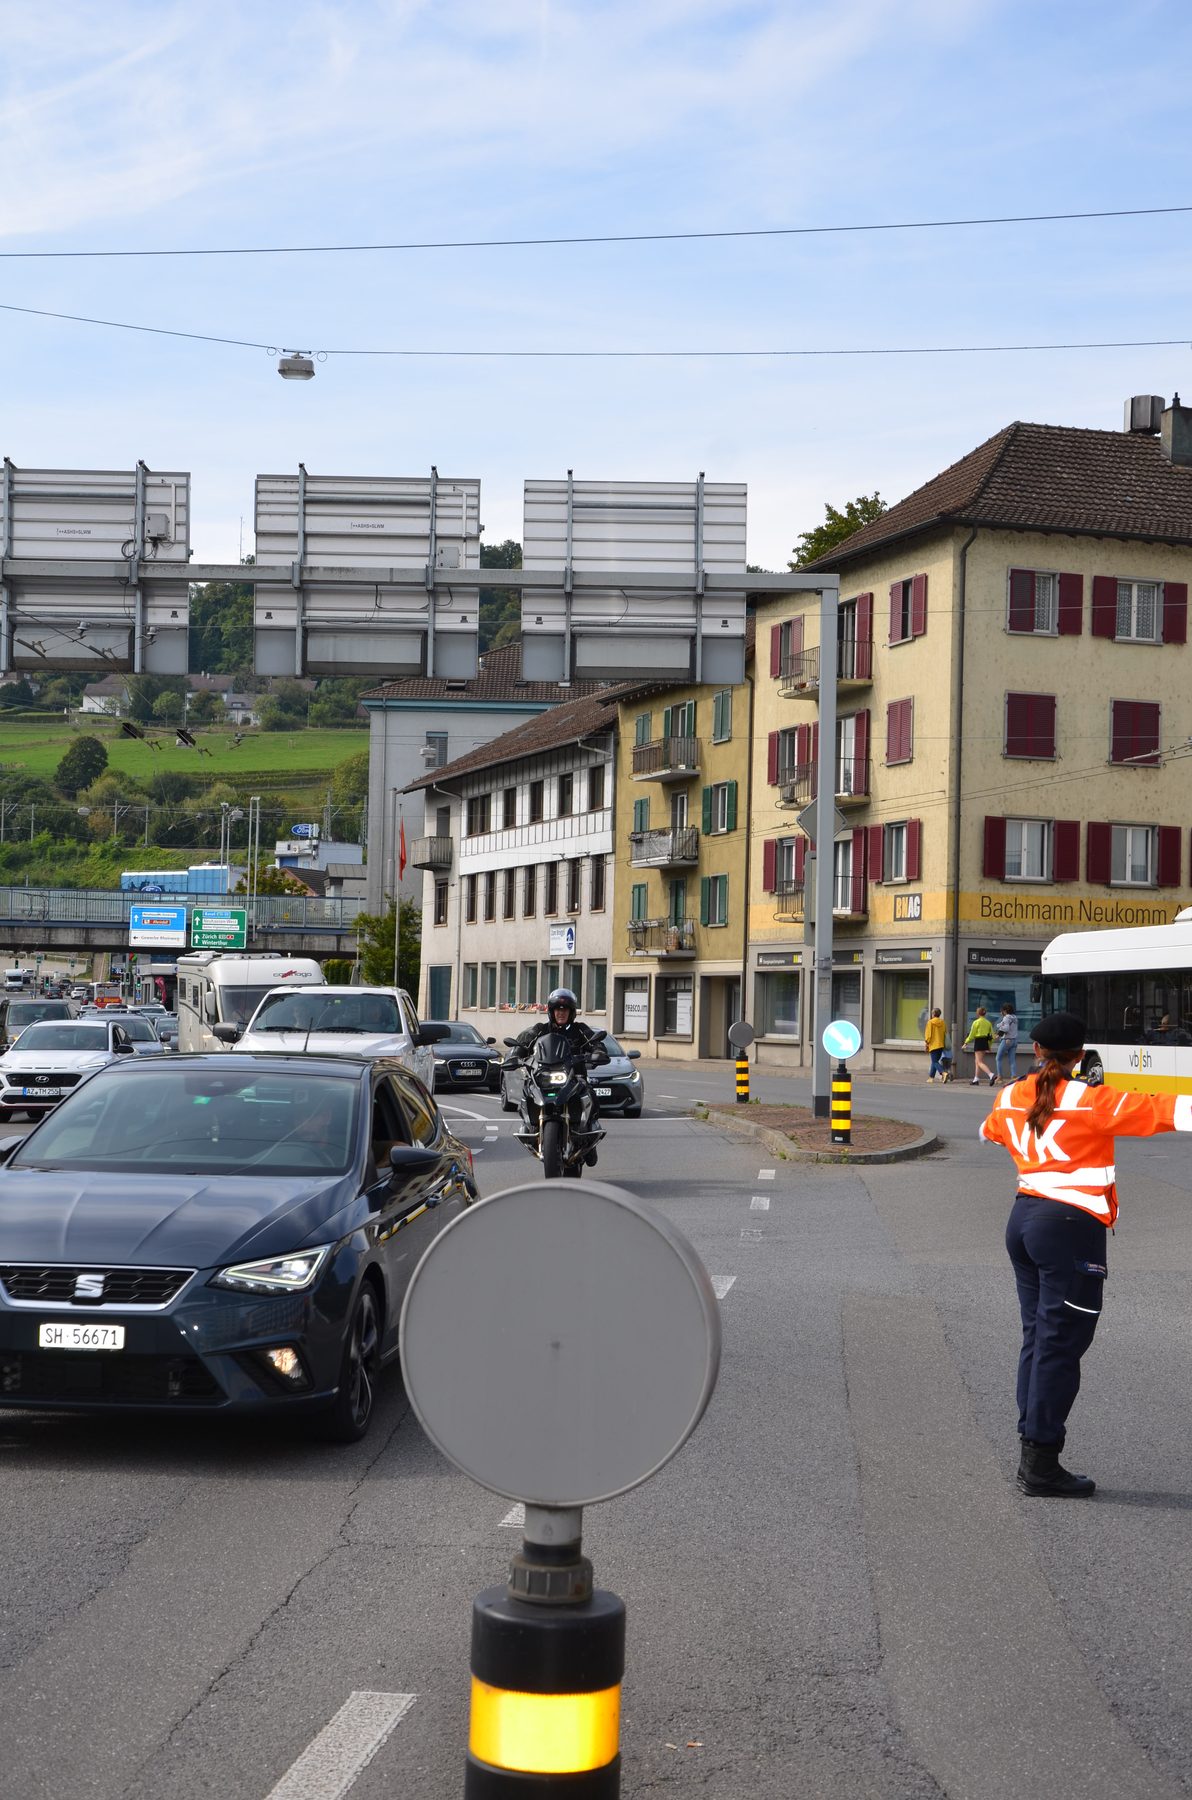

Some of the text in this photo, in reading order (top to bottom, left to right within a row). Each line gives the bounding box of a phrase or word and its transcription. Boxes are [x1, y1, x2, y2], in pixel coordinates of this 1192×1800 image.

[895, 895, 920, 918] BNAG
[981, 895, 1073, 921] Bachmann
[1079, 899, 1167, 924] Neukomm
[273, 970, 312, 978] cahago
[26, 1087, 35, 1095] AZ
[1005, 1117, 1072, 1164] VK
[45, 1327, 118, 1346] SH 56671
